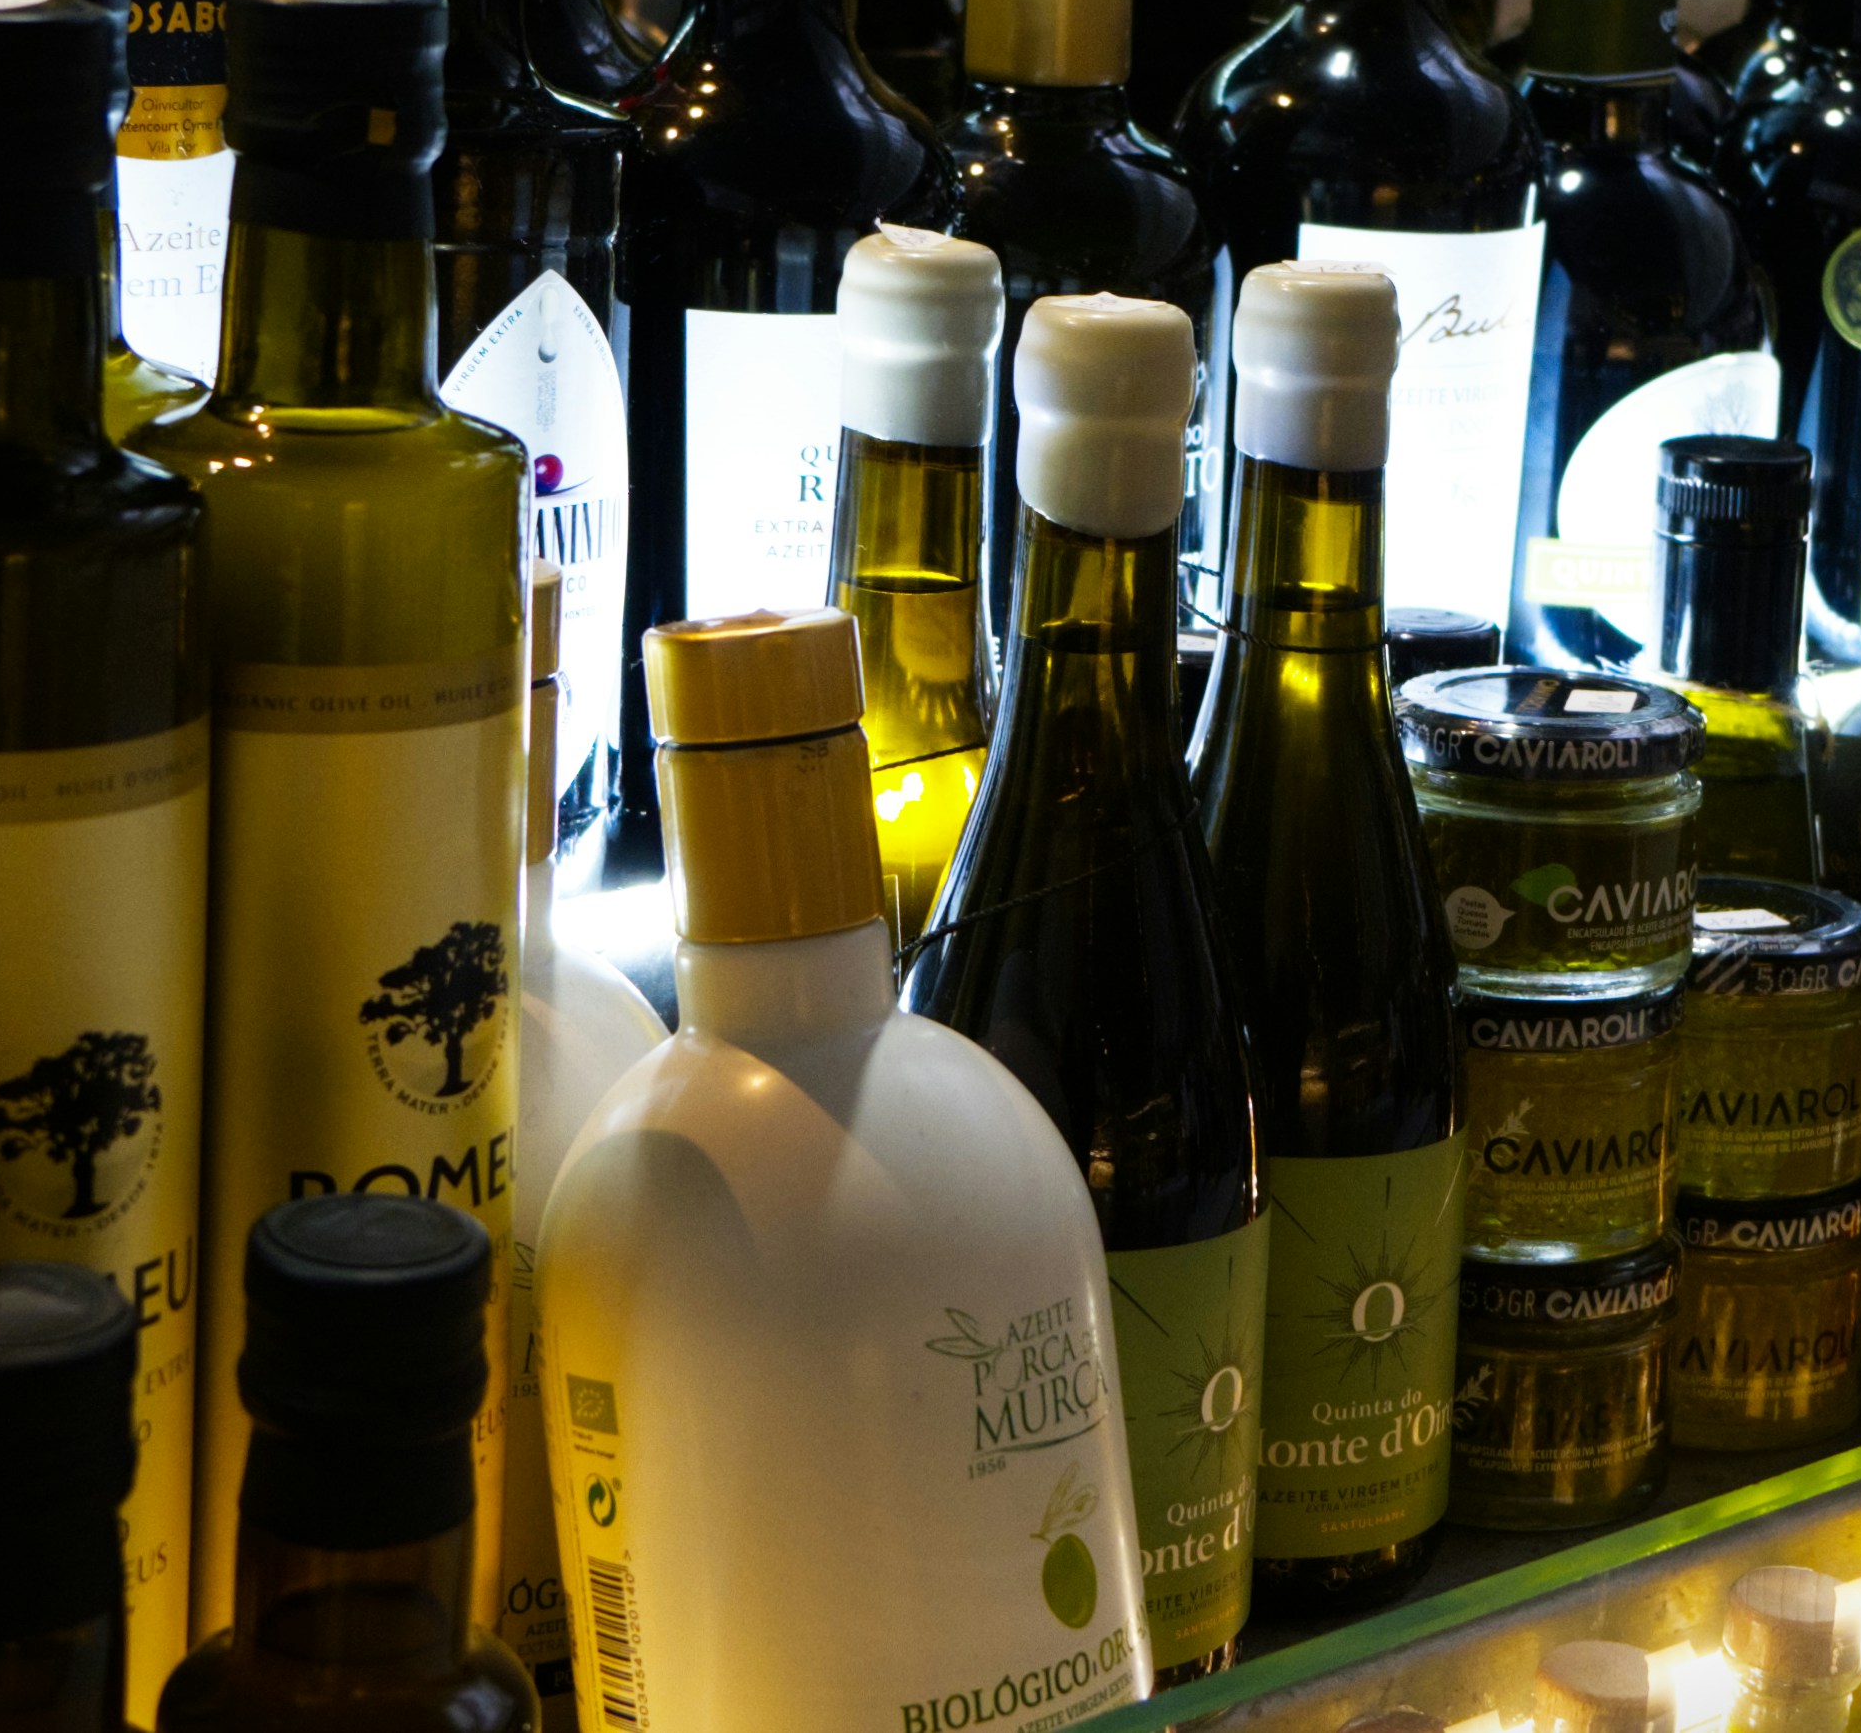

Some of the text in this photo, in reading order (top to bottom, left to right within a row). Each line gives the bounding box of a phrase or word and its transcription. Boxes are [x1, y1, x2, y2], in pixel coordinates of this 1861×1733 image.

[141, 98, 205, 113] Olivicultor
[181, 118, 213, 134] Cyrne
[147, 138, 197, 154] Vila Flor
[121, 220, 222, 252] Azeite
[126, 273, 182, 297] em
[572, 304, 595, 337] EXTRA
[453, 307, 525, 393] VIRGEM EXTRA
[798, 474, 825, 502] R
[754, 519, 824, 534] EXTRA
[765, 544, 826, 559] AZEIT
[565, 574, 587, 594] CO
[1473, 734, 1639, 771] CAVIAROLI
[1456, 906, 1488, 920] Quesos
[1459, 897, 1487, 910] Pastas
[1456, 917, 1488, 929] Tomate
[1566, 922, 1627, 939] ENCAPSULADO
[1471, 1007, 1645, 1049] CAVIAROLI
[367, 1032, 451, 1116] TERRA MATER
[1544, 1271, 1671, 1320] CAVIAROLI
[1005, 1297, 1074, 1344] AZEITE
[972, 1330, 1078, 1397] PORCA
[972, 1358, 1109, 1452] MURÇA
[1312, 1387, 1423, 1425] Quinta do
[966, 1456, 1007, 1481] 1956
[1258, 1478, 1400, 1504] AZEITE VIRGEM
[1166, 1489, 1234, 1528] Quinta
[1319, 1508, 1407, 1534] SANTULHANA
[900, 1651, 1090, 1733] BIOLÓGICO
[1065, 1689, 1109, 1720] VIRGEM
